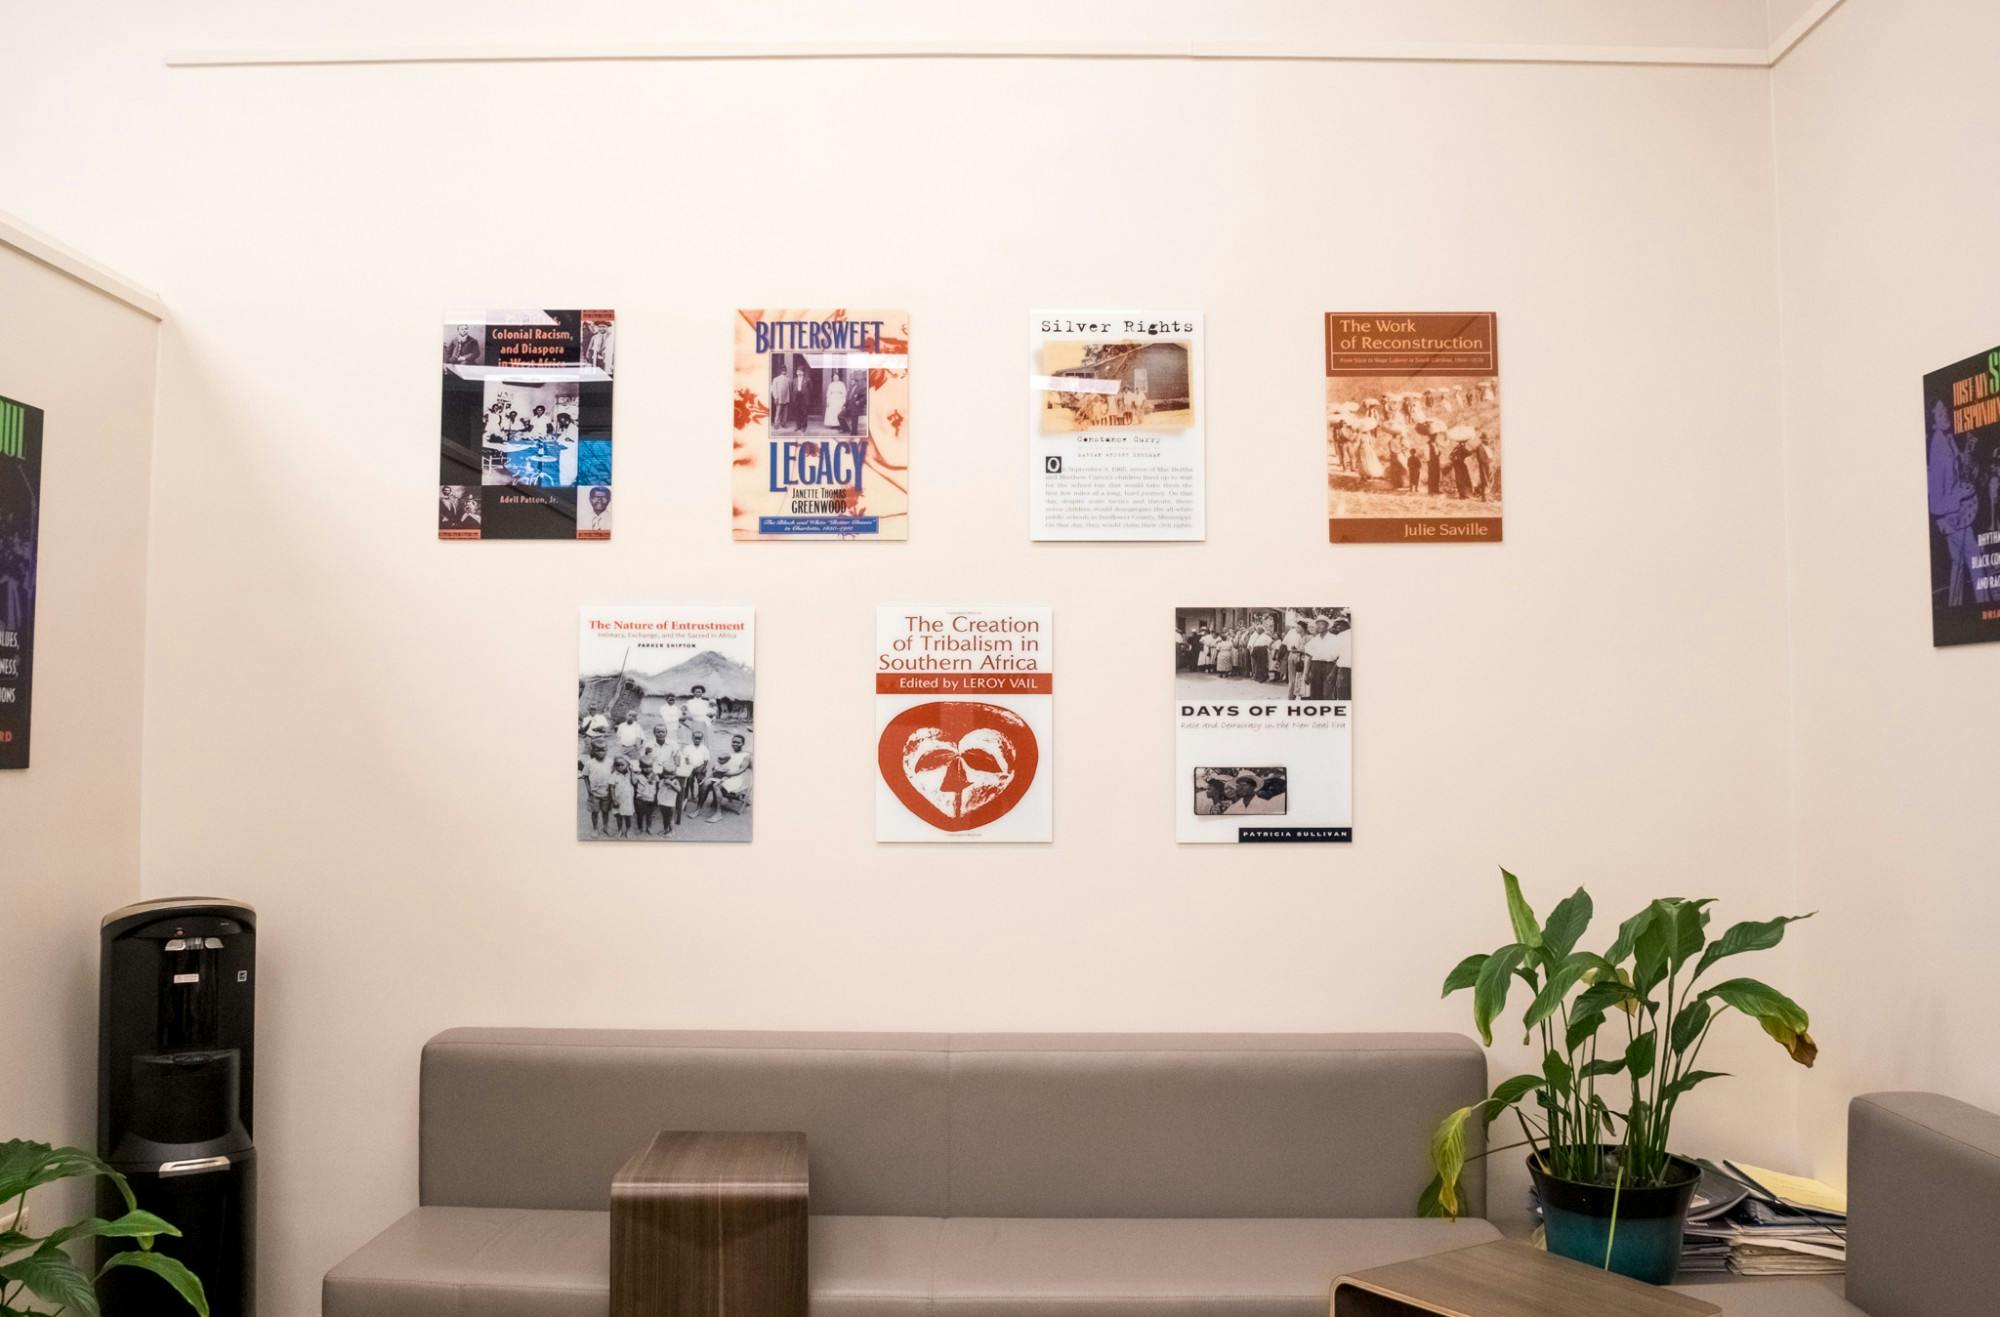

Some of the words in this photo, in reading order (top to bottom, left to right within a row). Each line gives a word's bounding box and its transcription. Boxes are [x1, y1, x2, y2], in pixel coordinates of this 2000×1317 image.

[1041, 320, 1112, 333] Silver
[1124, 320, 1194, 335] Rights
[1340, 319, 1371, 333] The
[1375, 319, 1416, 333] Work
[492, 328, 532, 340] Colonial
[535, 328, 574, 341] Racism,
[756, 321, 884, 354] BITTERSWEET
[500, 343, 518, 354] and
[522, 343, 565, 357] Diaspora
[1340, 336, 1360, 350] of
[1362, 336, 1483, 350] Reconstruction
[769, 441, 868, 492] LEGACY
[500, 496, 518, 504] Adell
[792, 488, 818, 499] JANETTE
[821, 488, 846, 499] THOMAS
[792, 500, 847, 514] GREENWOOD
[1404, 523, 1436, 538] Julie
[1440, 523, 1488, 536] Saville
[590, 620, 610, 630] The
[614, 620, 653, 630] Nature
[656, 620, 669, 630] of
[672, 620, 744, 630] Entrustment
[905, 616, 944, 633] The
[952, 616, 1039, 633] Creation
[892, 636, 912, 652] of
[920, 635, 1012, 652] Tribalism
[1022, 635, 1039, 652] in
[880, 654, 972, 670] Southern
[981, 654, 1038, 670] Africa
[900, 678, 939, 688] Edited
[943, 678, 960, 691] by
[964, 678, 1006, 688] LEROY
[1009, 678, 1038, 688] VAIL
[1182, 706, 1240, 717] DAYS
[1249, 706, 1278, 717] OF
[1288, 706, 1347, 717] HOPE
